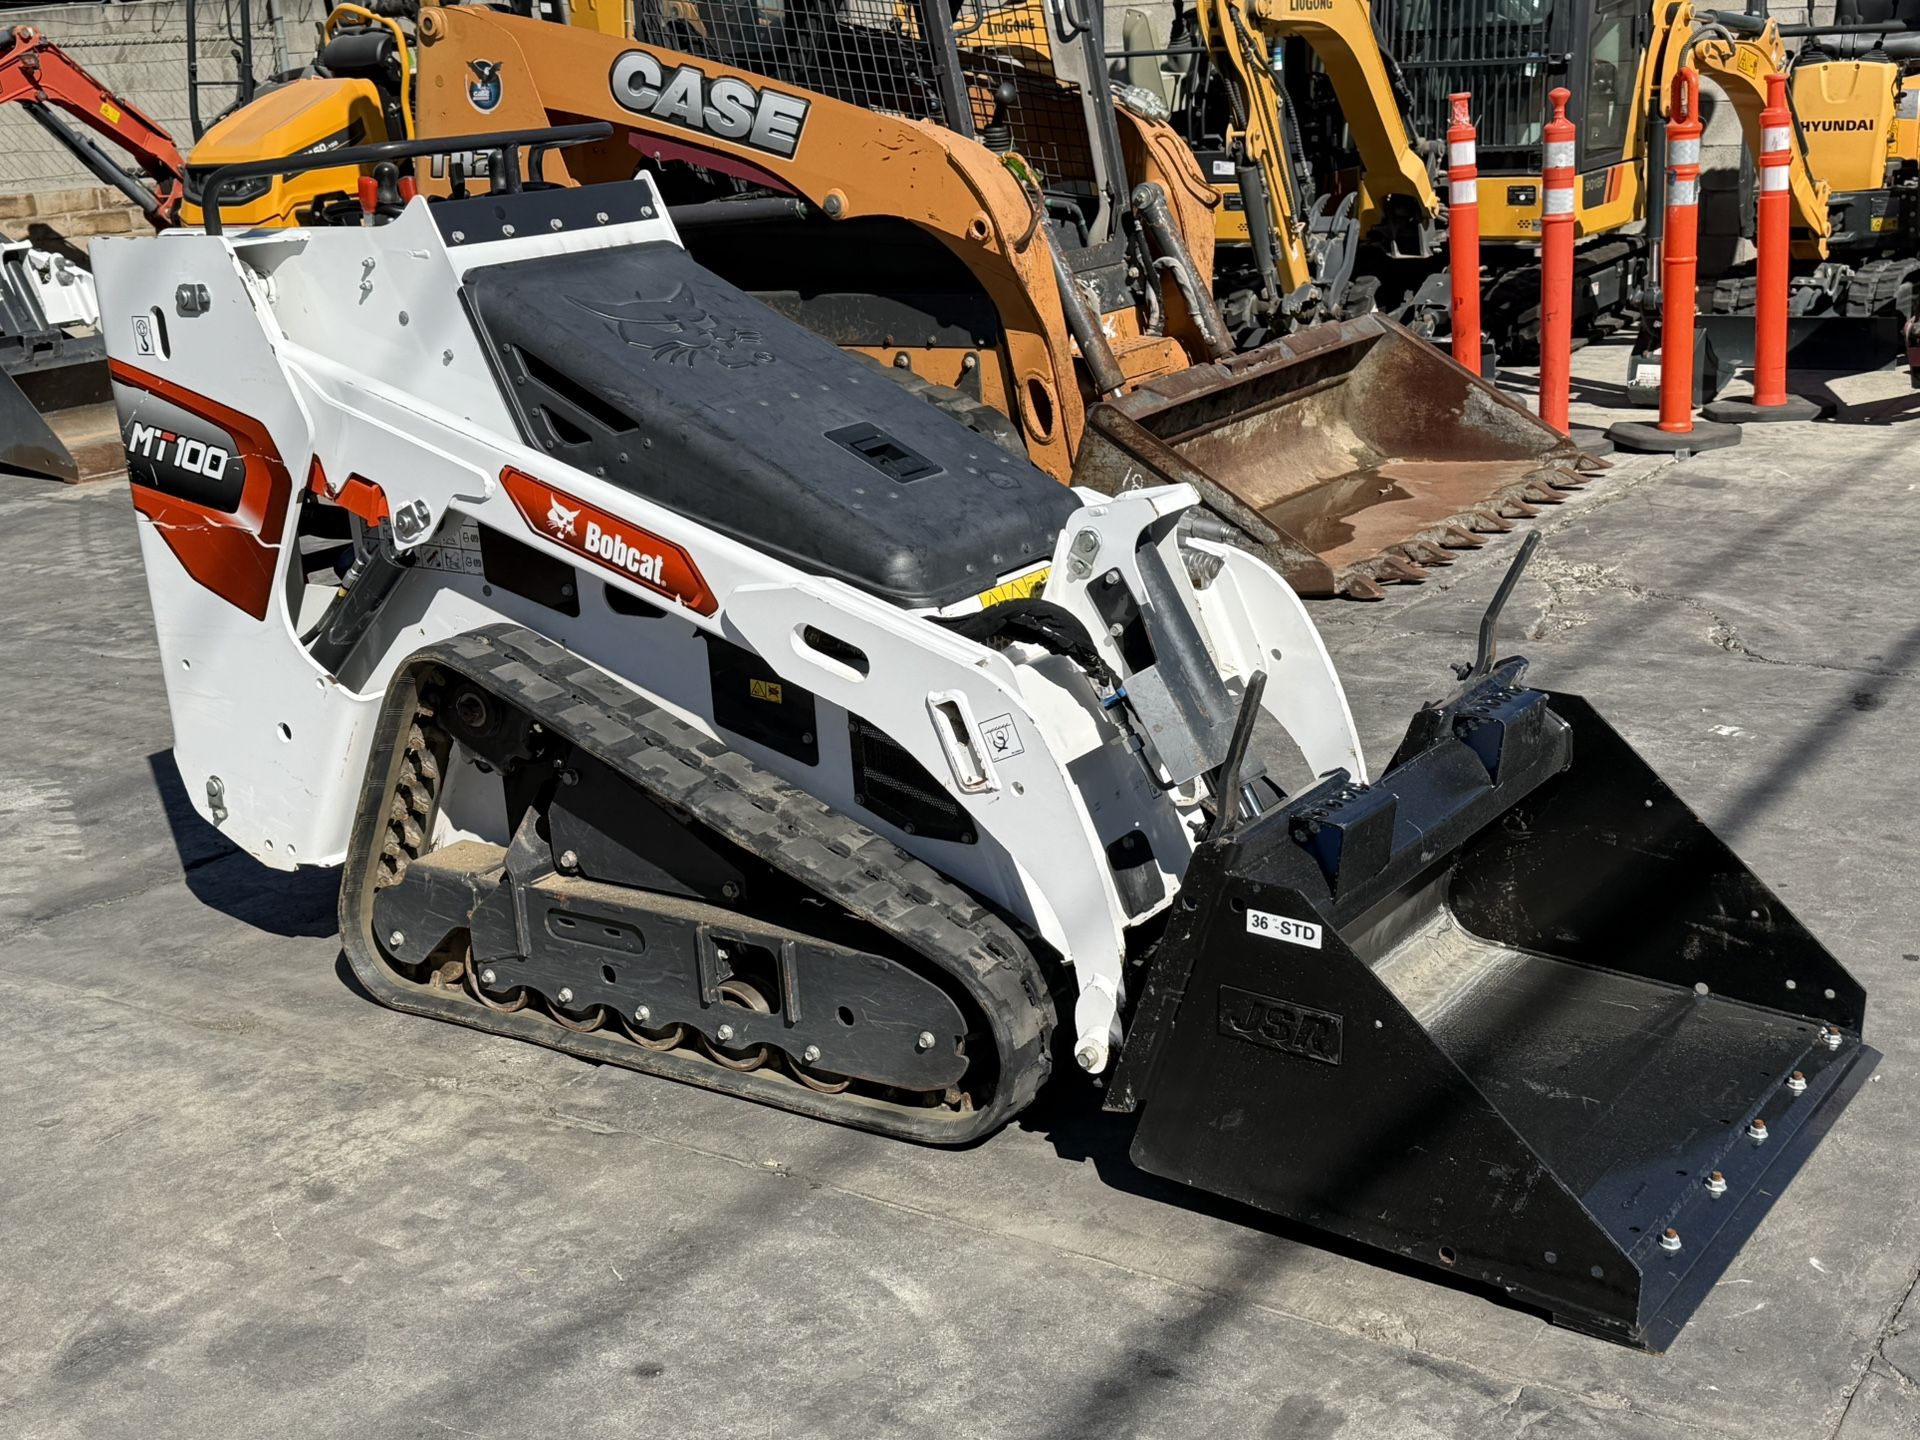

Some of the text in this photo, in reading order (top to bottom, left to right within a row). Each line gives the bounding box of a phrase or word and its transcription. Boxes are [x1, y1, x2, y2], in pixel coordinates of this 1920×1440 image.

[1290, 0, 1333, 11] LIUGONG
[611, 51, 807, 154] CASE
[1801, 120, 1874, 132] HYUNDAI
[128, 421, 229, 481] MT100
[585, 520, 665, 586] Bobcat
[1251, 914, 1268, 930] 36
